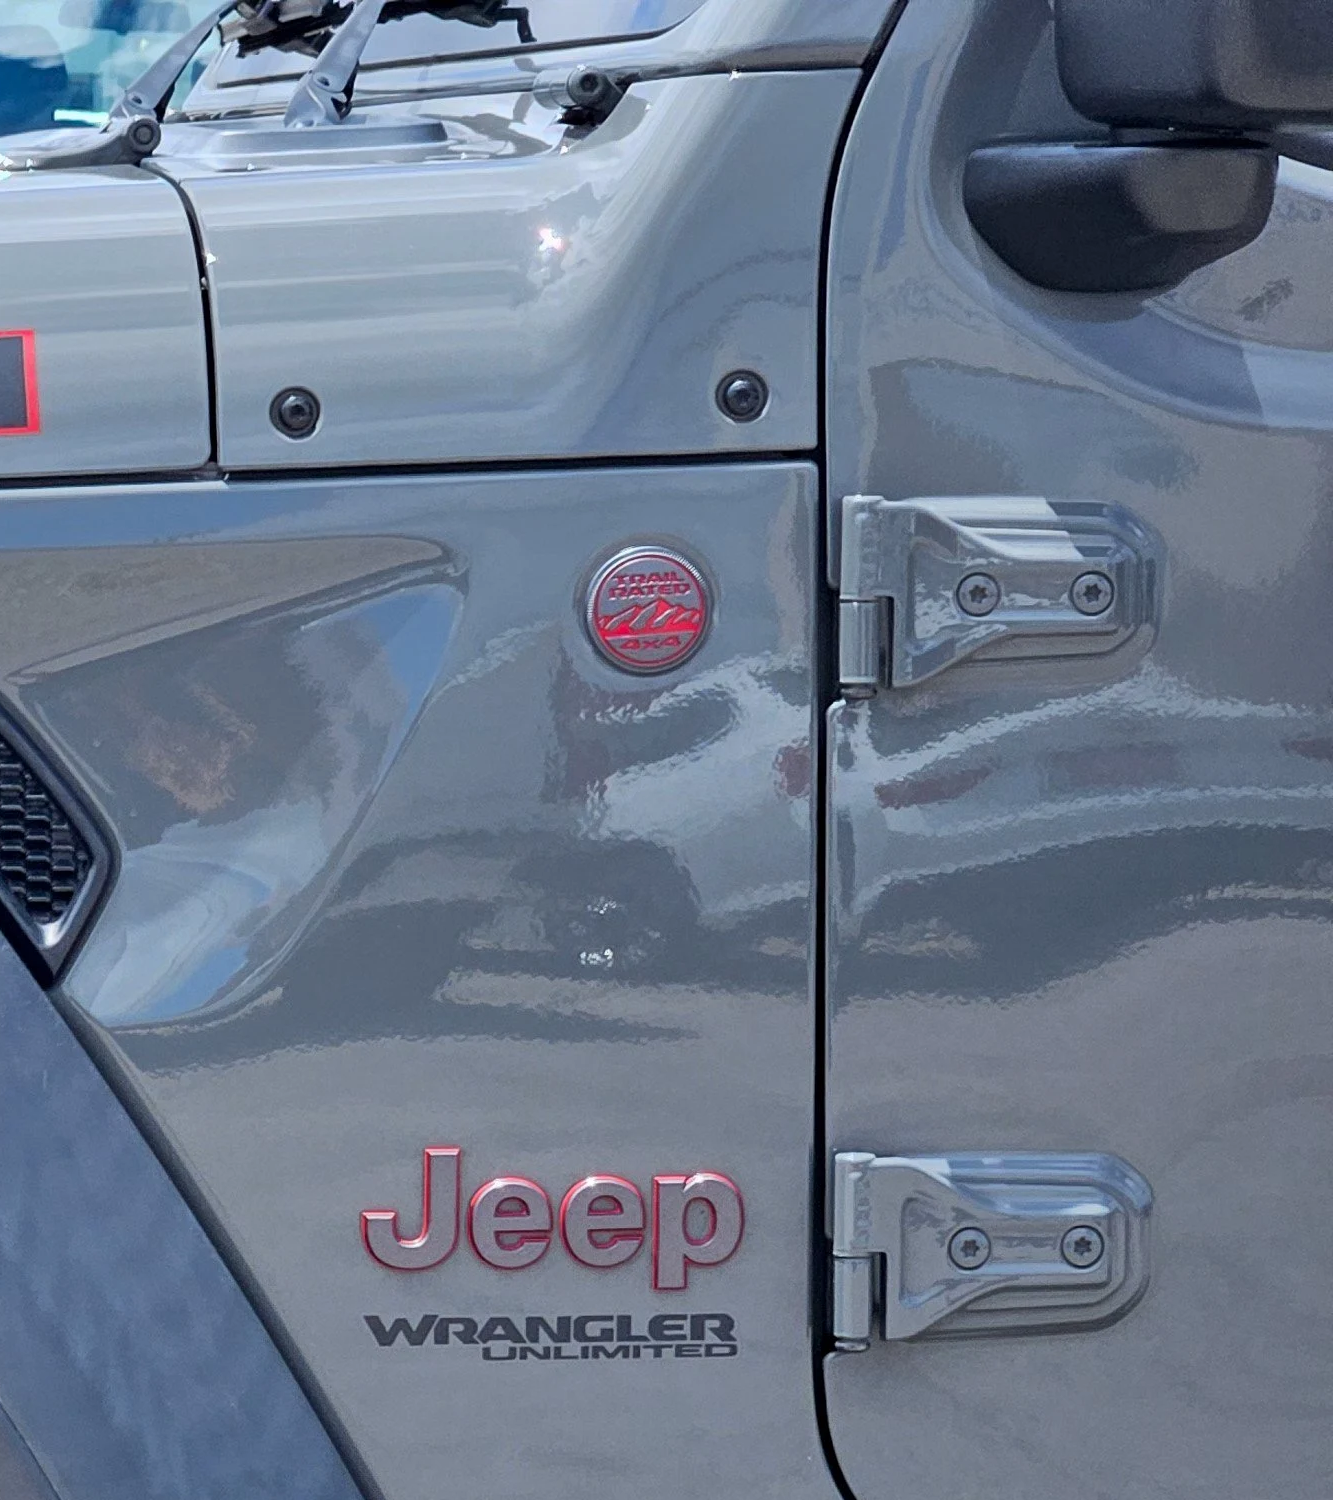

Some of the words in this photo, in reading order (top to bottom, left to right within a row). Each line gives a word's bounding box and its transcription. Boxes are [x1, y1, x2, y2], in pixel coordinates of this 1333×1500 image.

[613, 571, 685, 586] TRAIL
[607, 583, 691, 600] RATED
[360, 1144, 745, 1291] Jeep
[363, 1313, 737, 1347] WRANGLER
[481, 1344, 737, 1361] UNLIMITED
